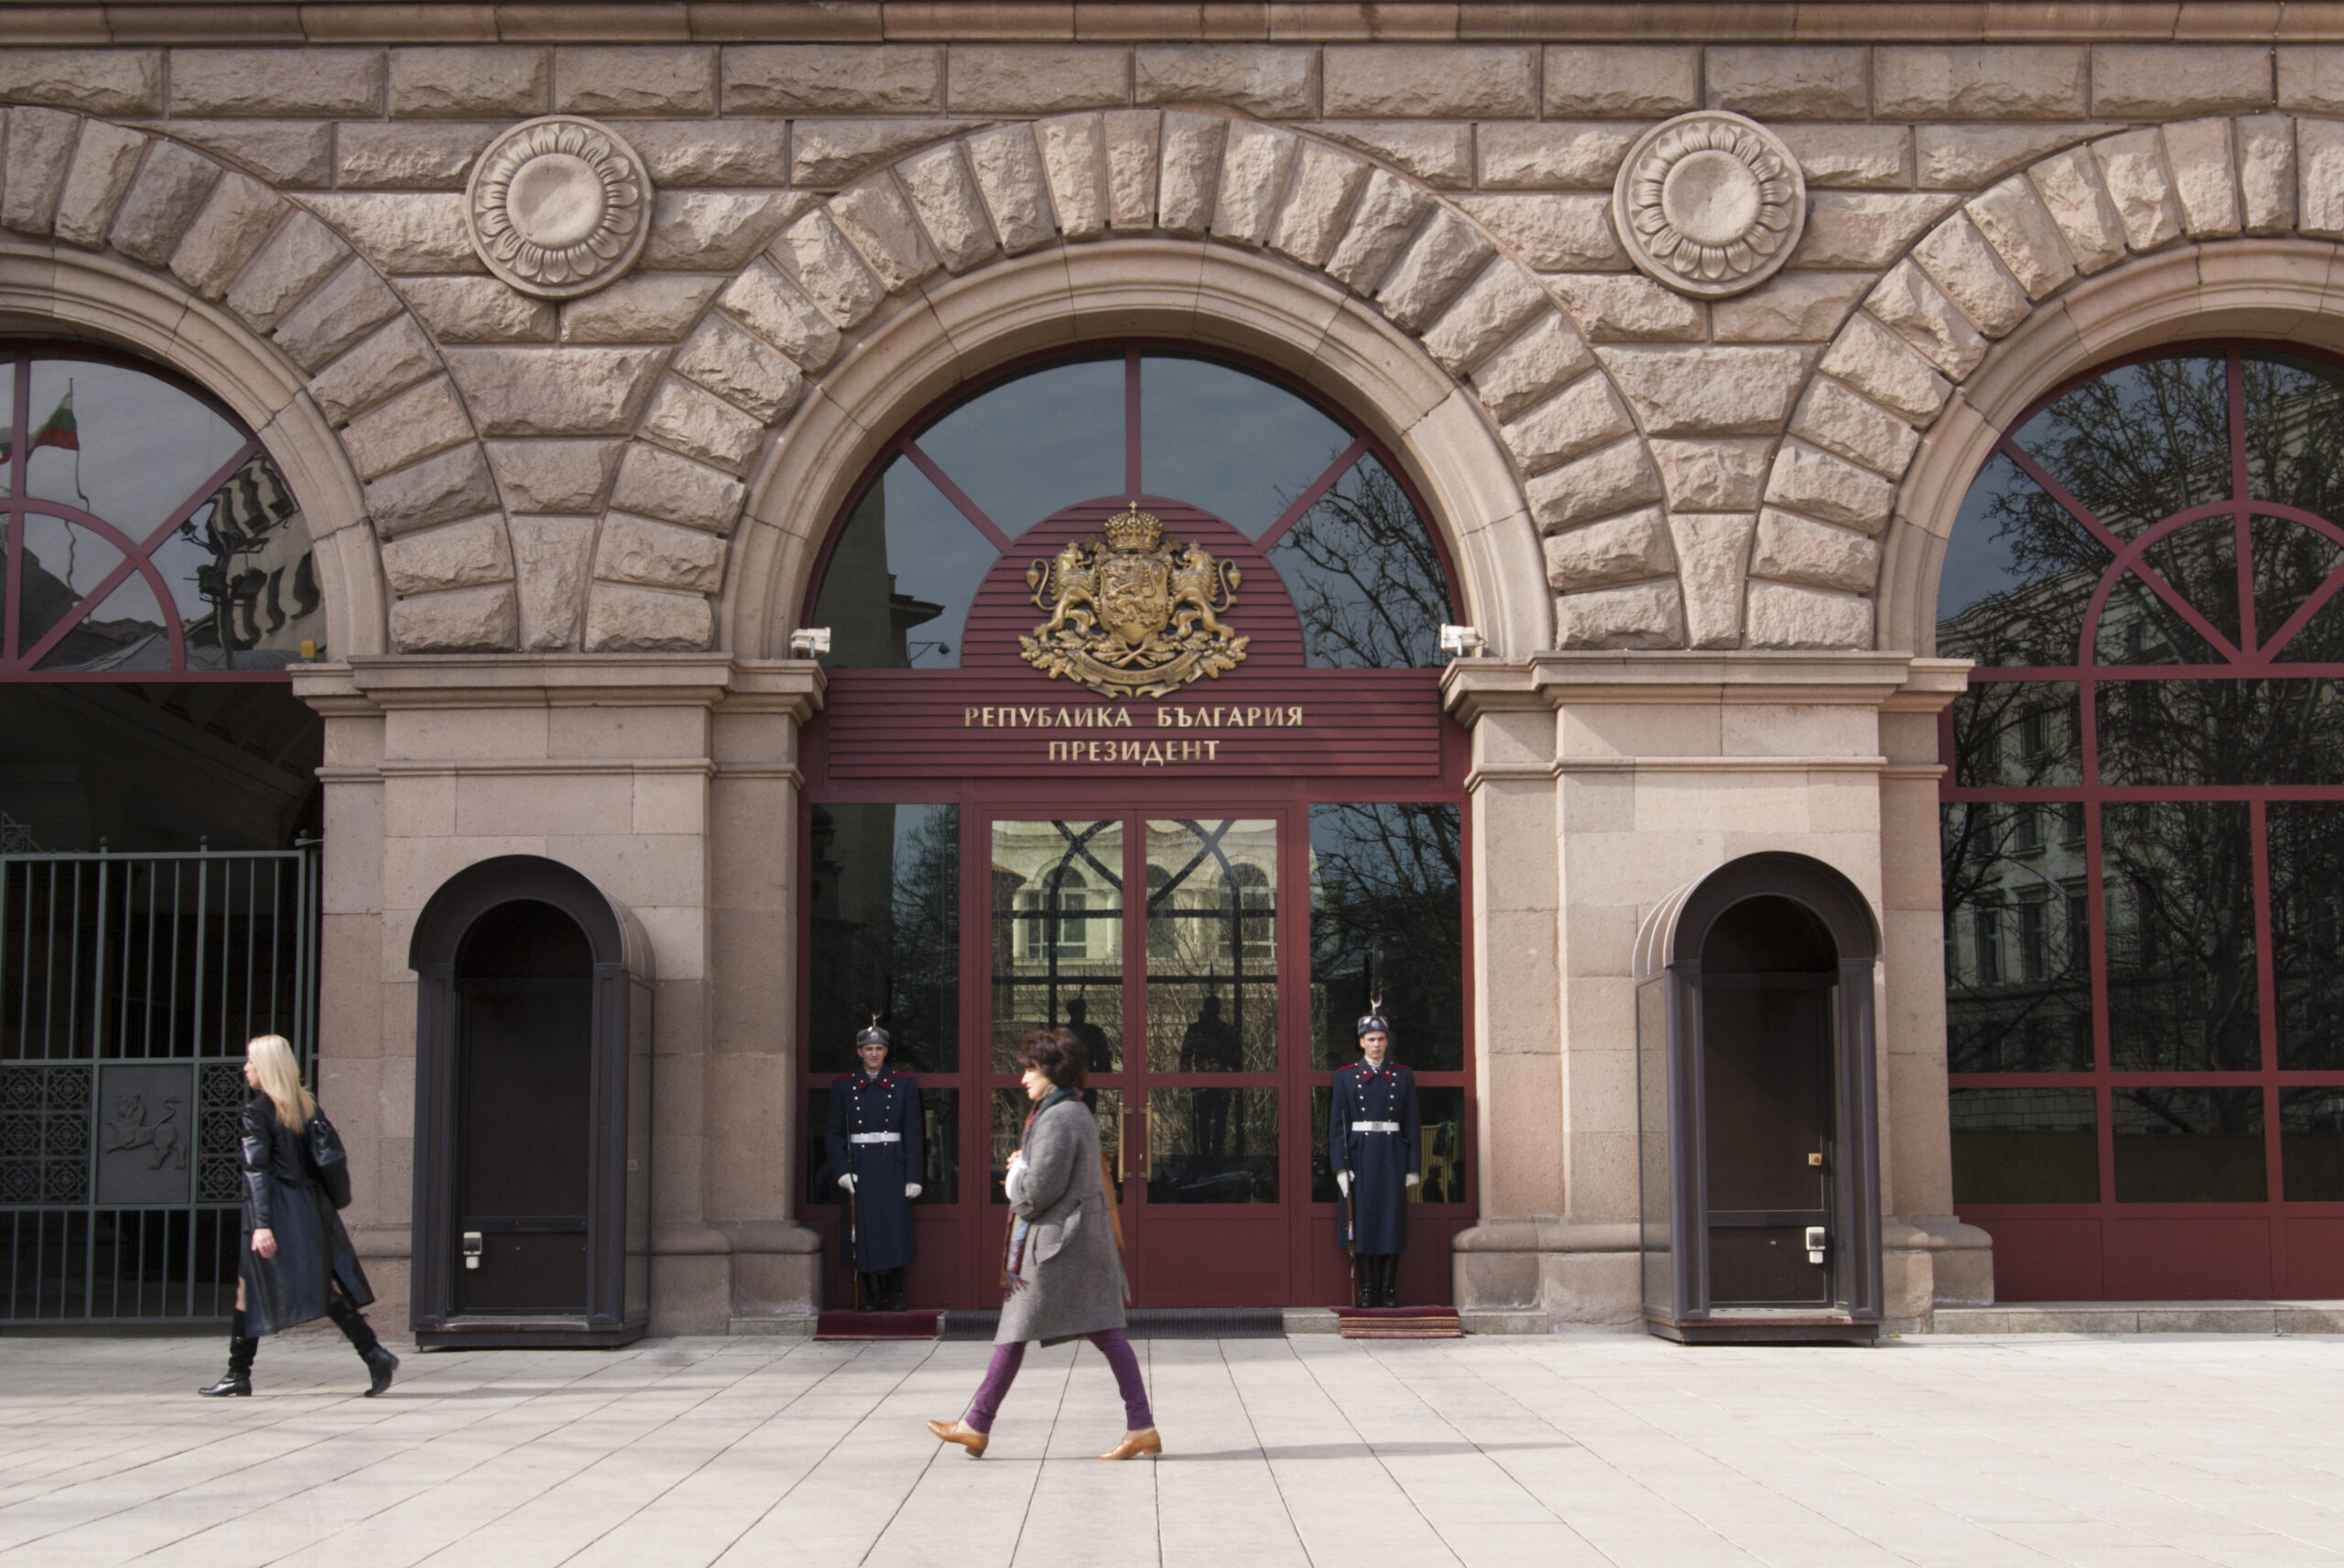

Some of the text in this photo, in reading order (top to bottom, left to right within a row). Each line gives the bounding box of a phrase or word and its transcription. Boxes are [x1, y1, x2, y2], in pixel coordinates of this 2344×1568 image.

[964, 707, 1302, 728] РЕПУБЛИКА БЪЛГАРИЯ
[1049, 741, 1220, 766] ПРЕЗИДЕНТ
